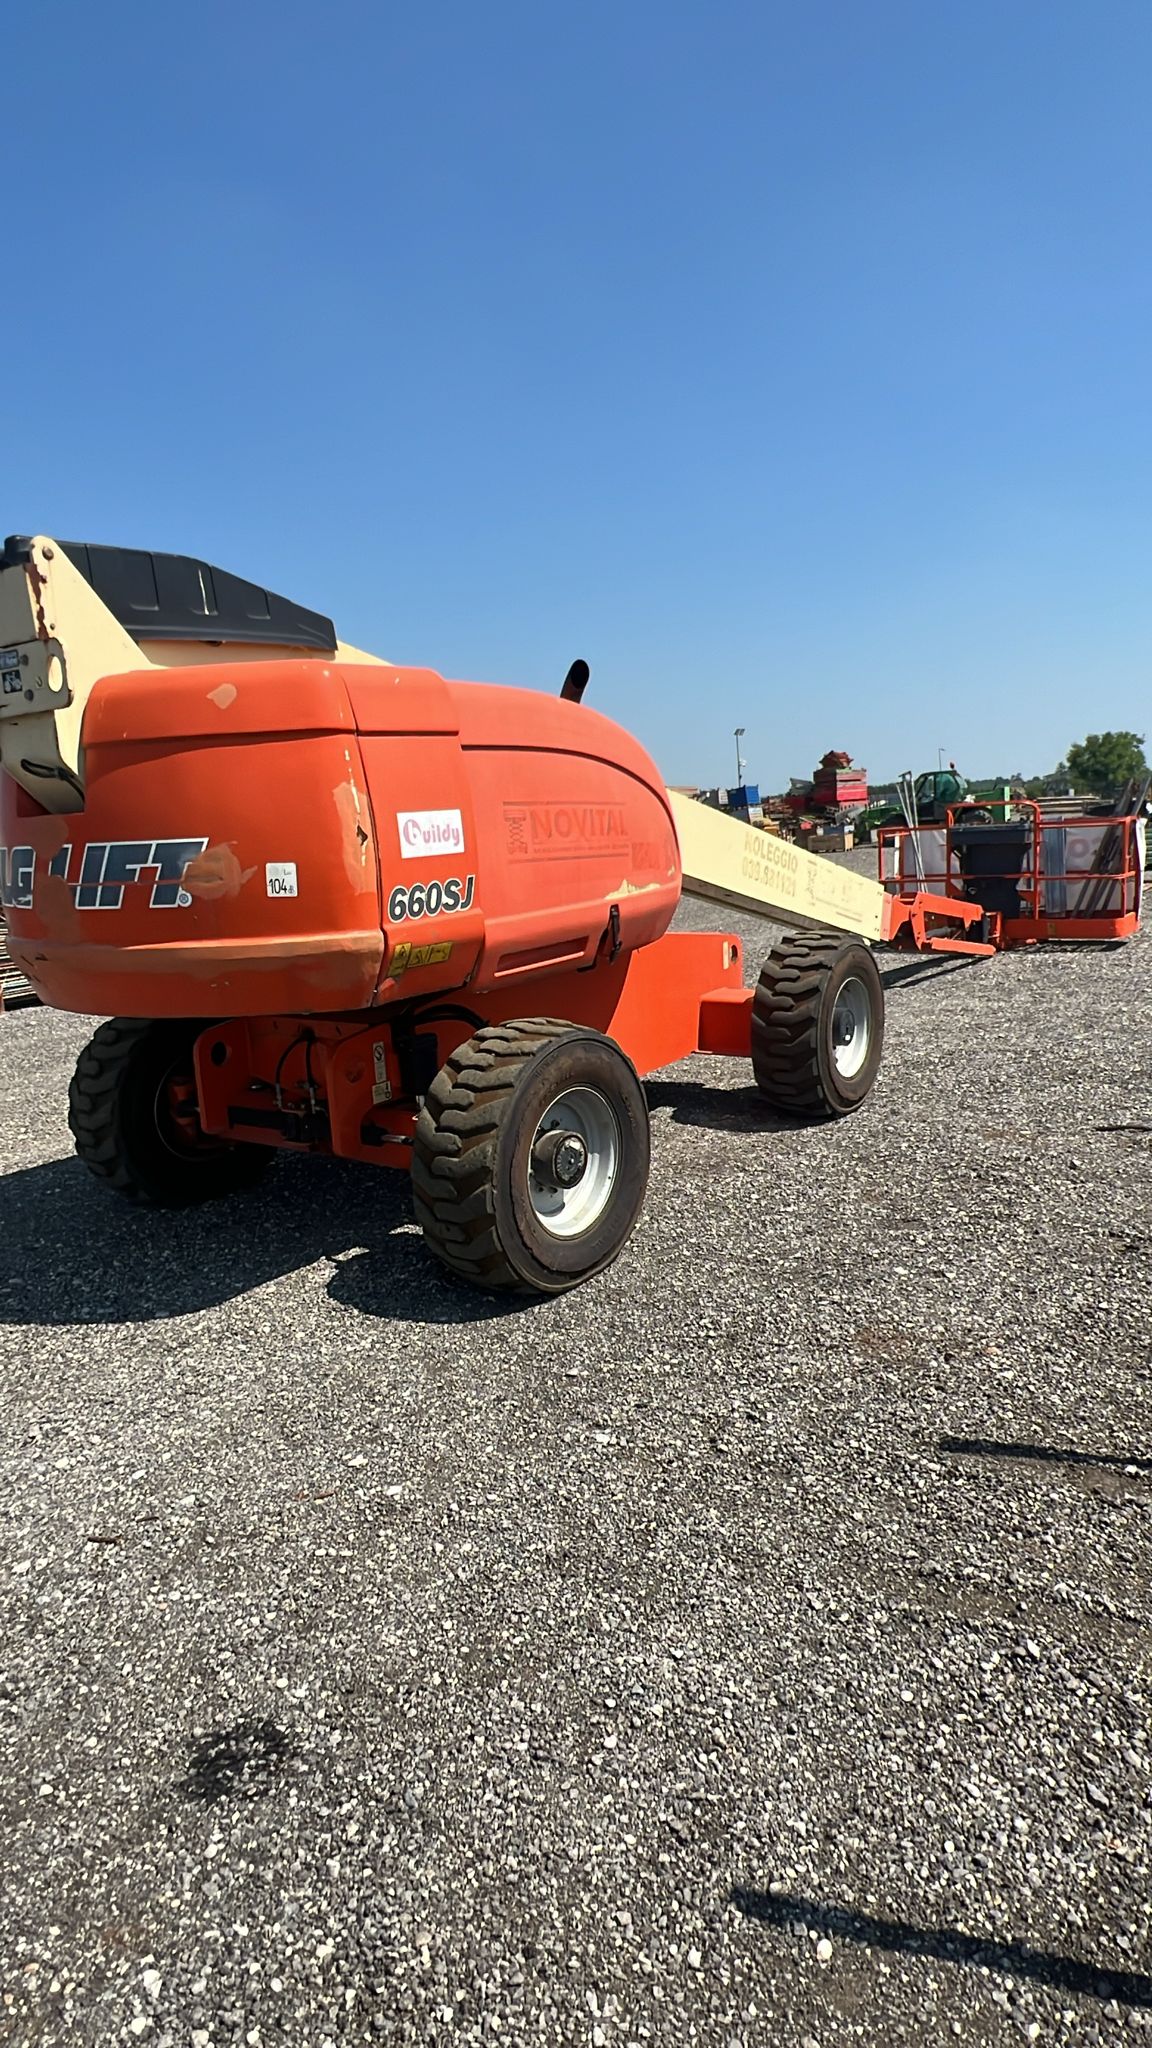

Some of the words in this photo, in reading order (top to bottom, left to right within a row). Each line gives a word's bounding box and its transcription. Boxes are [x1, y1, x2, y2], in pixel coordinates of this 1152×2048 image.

[530, 808, 628, 839] NOVITAL
[268, 878, 287, 894] 104
[388, 875, 475, 923] 660SJ
